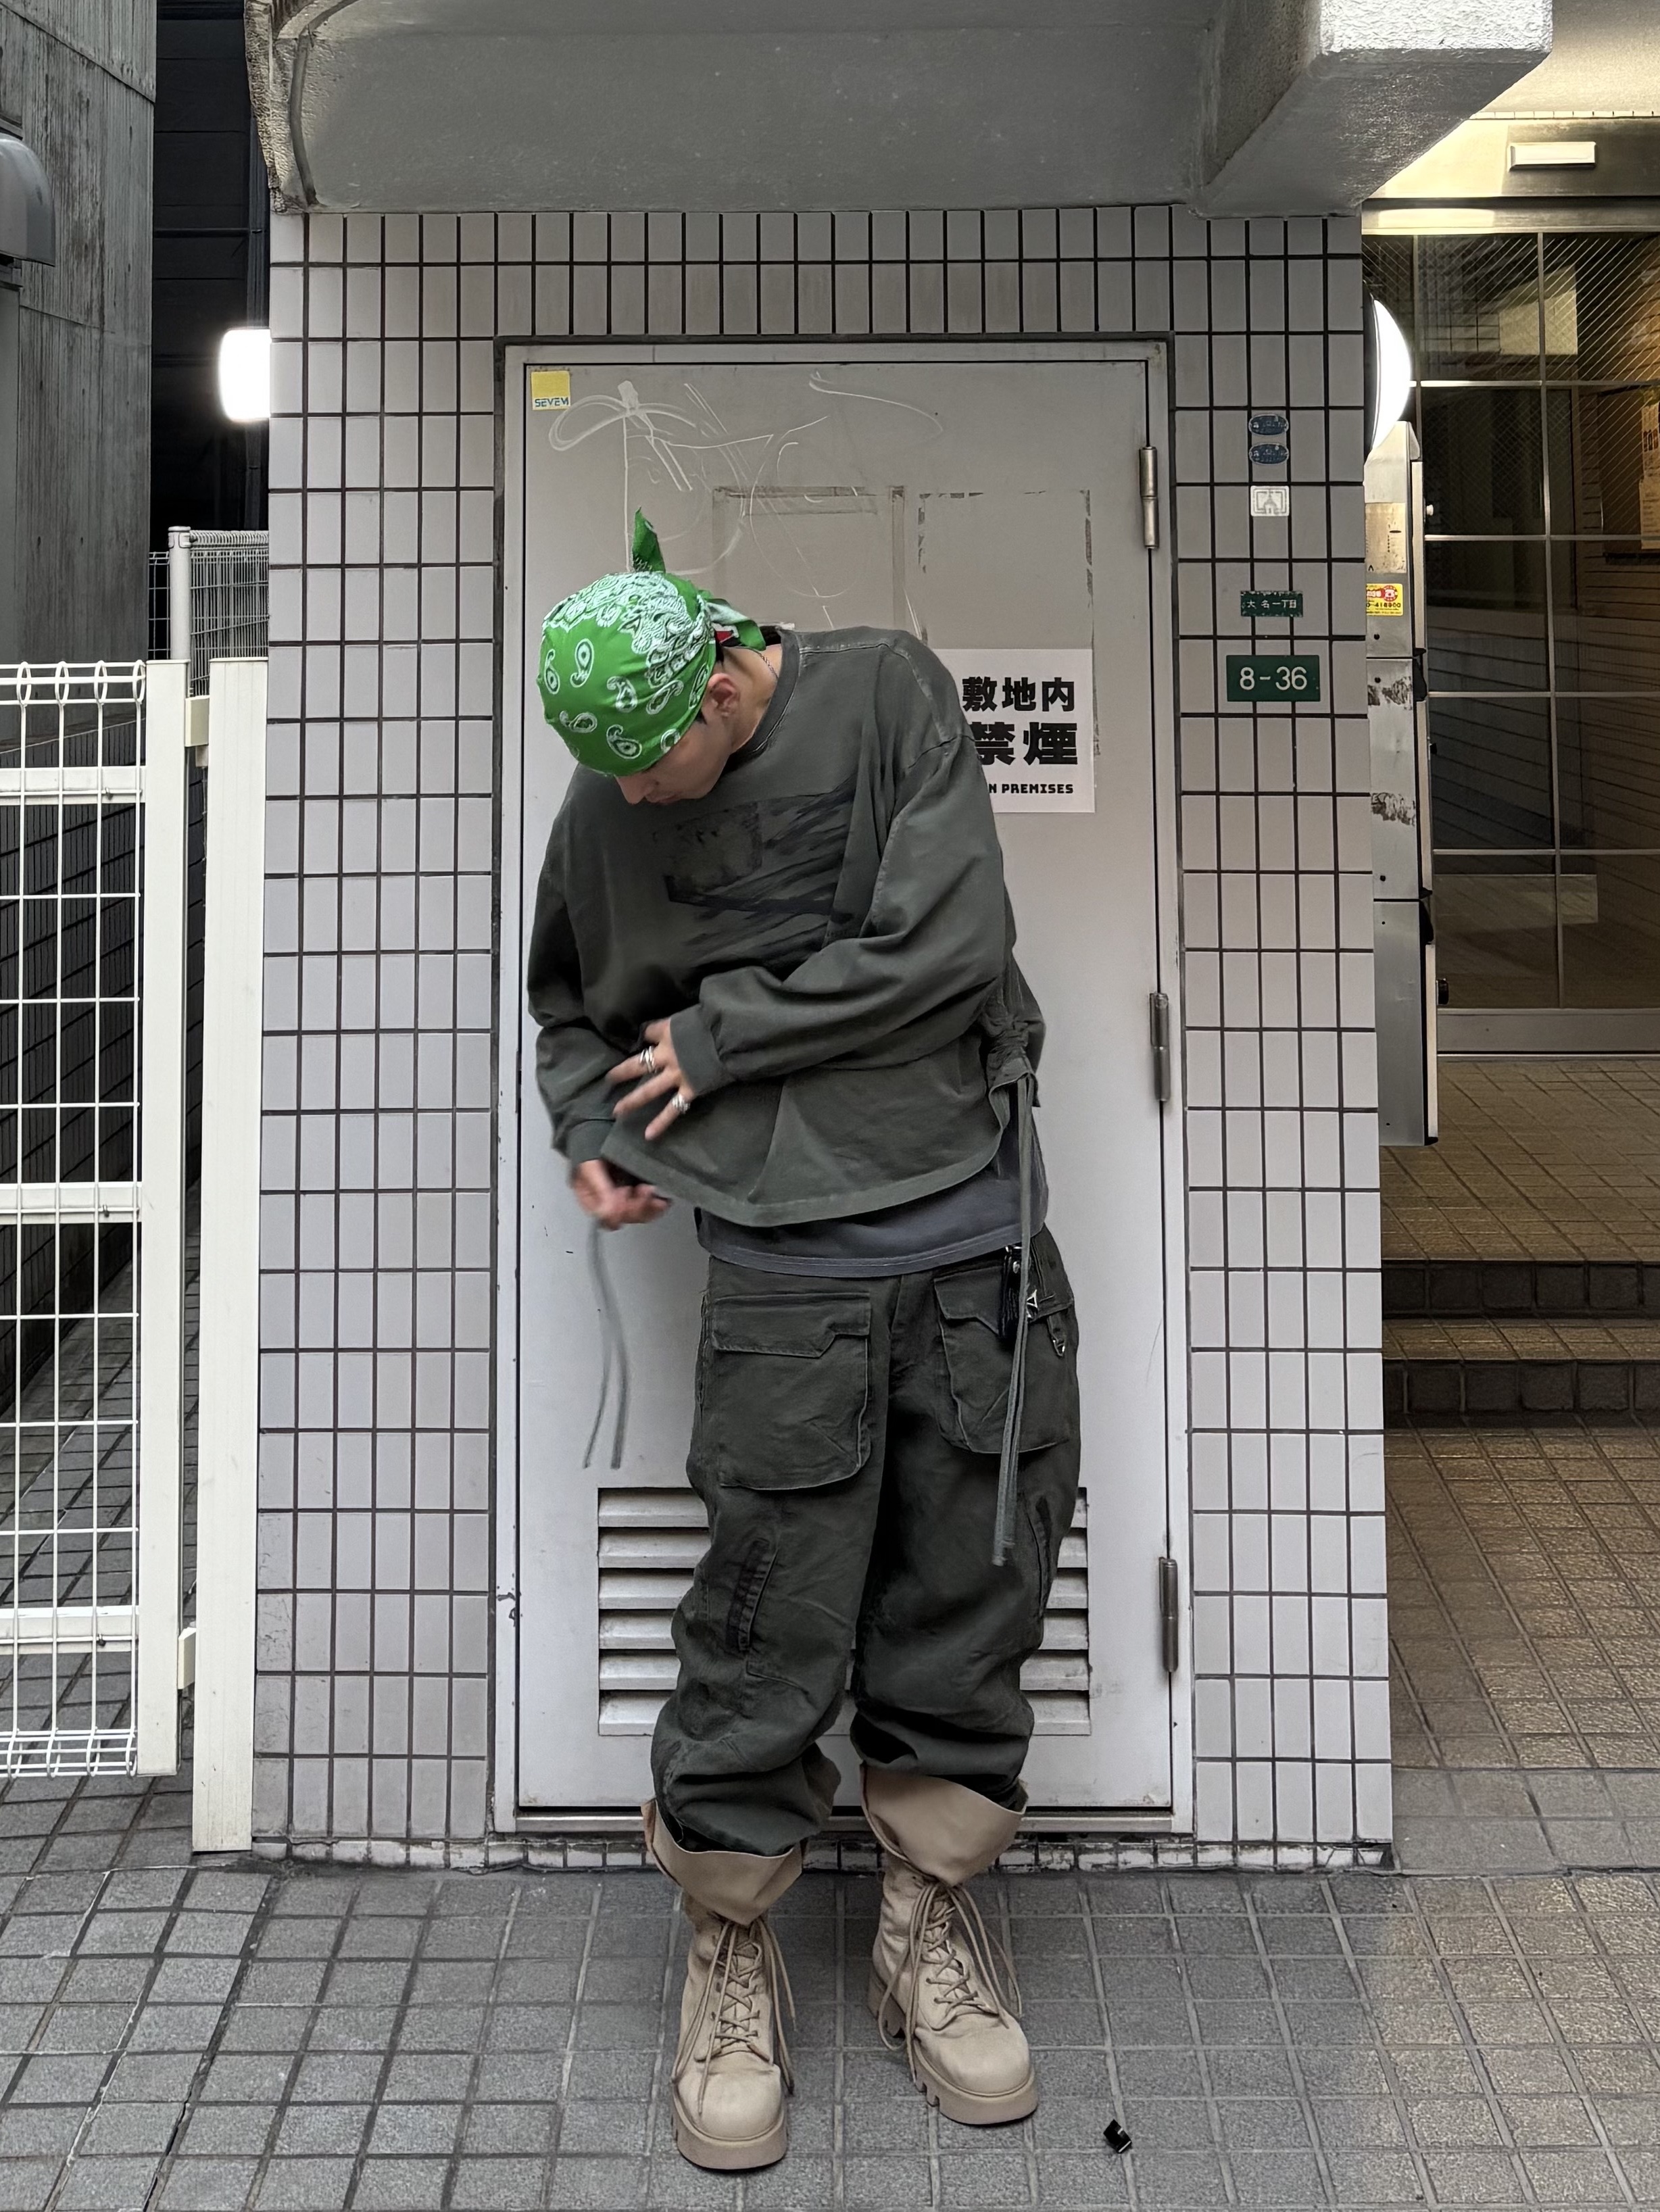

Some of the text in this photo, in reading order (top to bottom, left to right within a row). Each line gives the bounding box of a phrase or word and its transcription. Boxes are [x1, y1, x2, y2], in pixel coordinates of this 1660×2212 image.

[1239, 666, 1307, 691] 8-36
[962, 676, 1075, 712] 敷地内
[969, 721, 1078, 766] 禁煙
[989, 783, 1073, 794] N PREMISES
